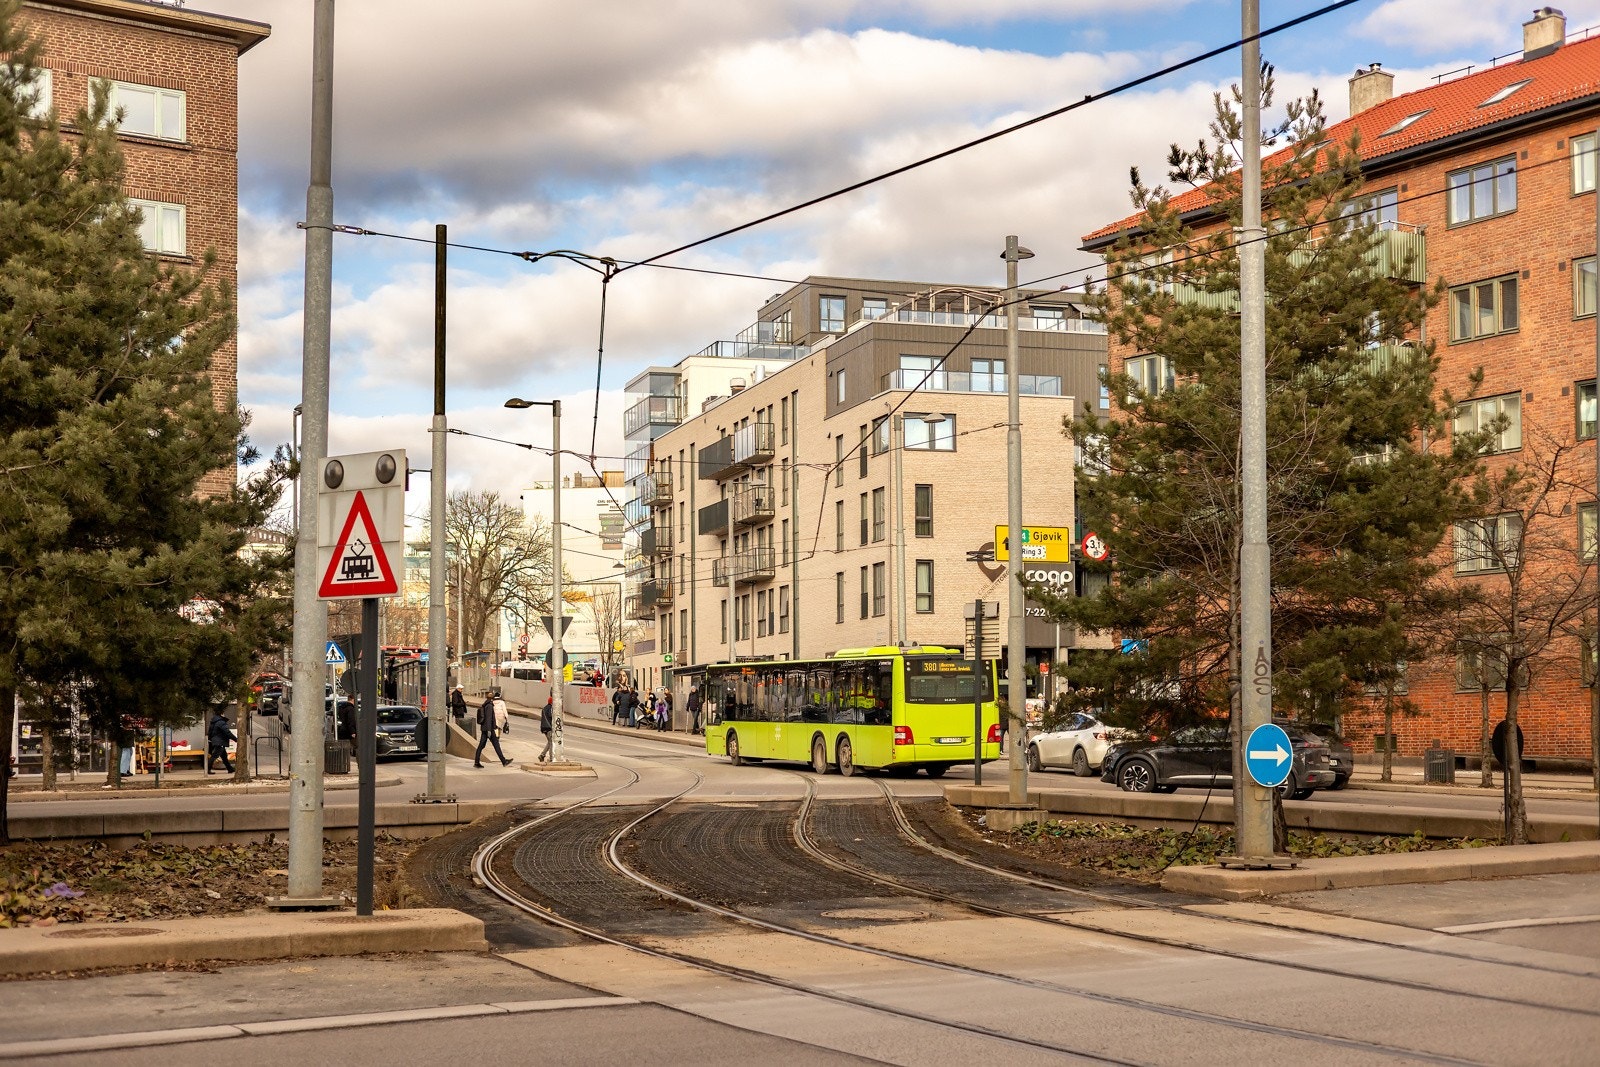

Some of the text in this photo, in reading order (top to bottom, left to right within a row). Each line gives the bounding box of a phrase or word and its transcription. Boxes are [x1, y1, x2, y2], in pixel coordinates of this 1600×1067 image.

[1033, 531, 1062, 543] Gjøvik
[1022, 548, 1036, 556] Ring
[1025, 570, 1074, 586] coop
[924, 662, 937, 671] 380
